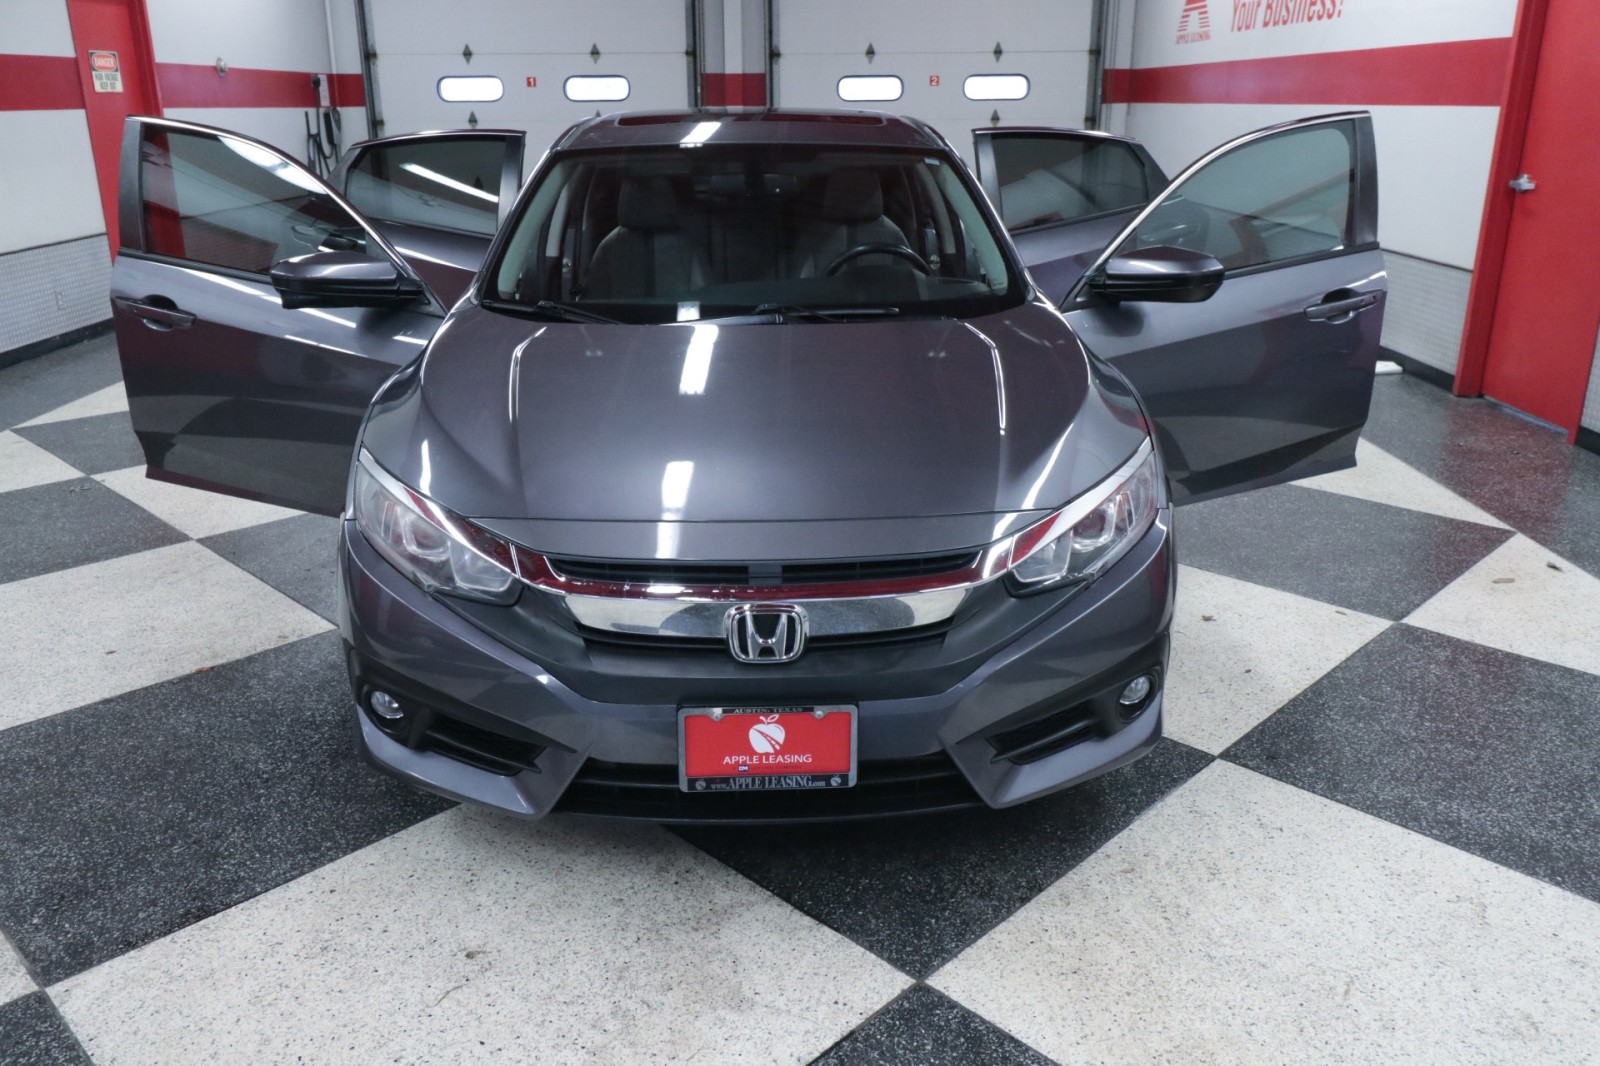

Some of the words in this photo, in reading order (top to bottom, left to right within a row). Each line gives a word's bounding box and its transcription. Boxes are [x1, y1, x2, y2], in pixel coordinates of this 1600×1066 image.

[1230, 0, 1262, 32] Your
[94, 57, 115, 67] DANGER
[931, 77, 938, 86] 2
[723, 756, 760, 765] APPLE
[762, 754, 812, 764] LEASING
